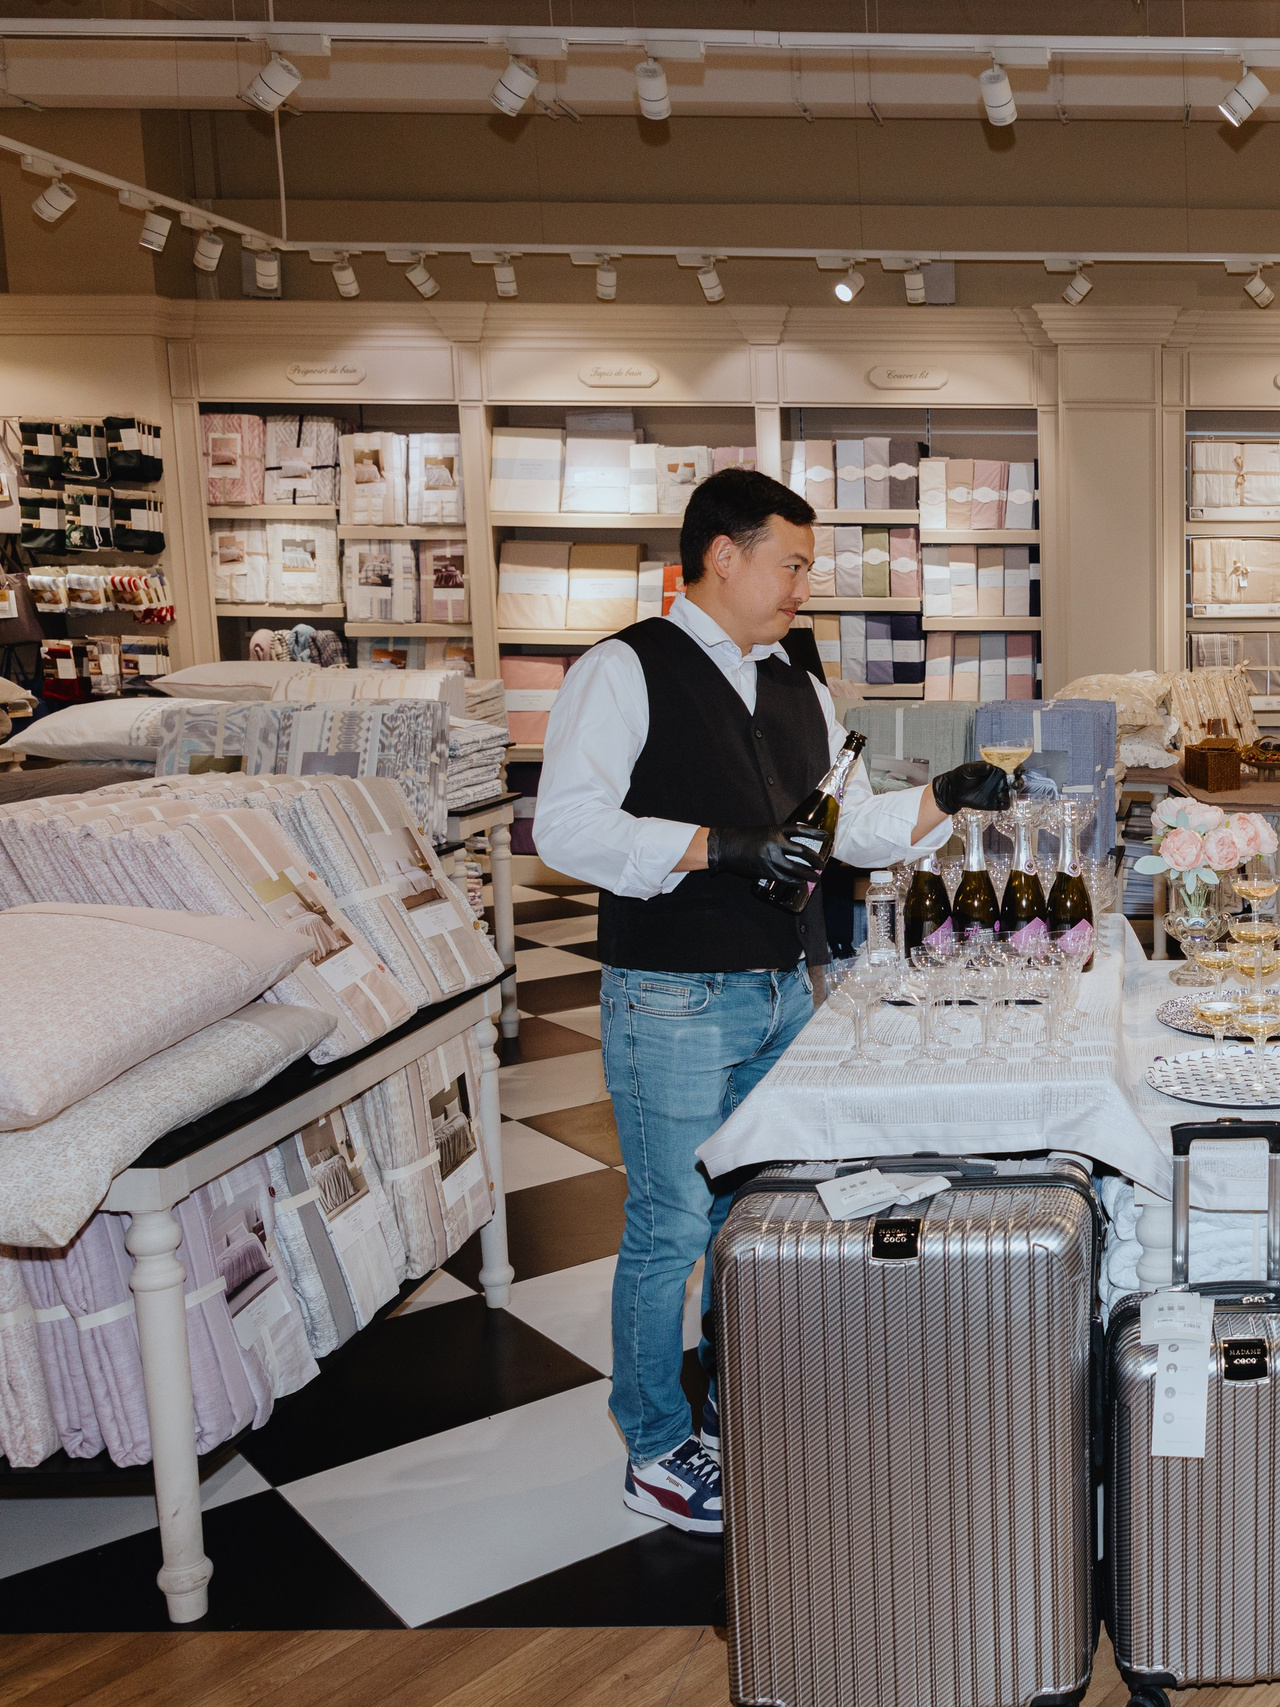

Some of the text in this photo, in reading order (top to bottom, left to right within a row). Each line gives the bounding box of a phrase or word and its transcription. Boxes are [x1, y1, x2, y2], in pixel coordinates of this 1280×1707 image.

[289, 365, 357, 377] Peignoirs de bain
[590, 367, 642, 379] Tapis de bain
[886, 369, 930, 379] Couvres lit
